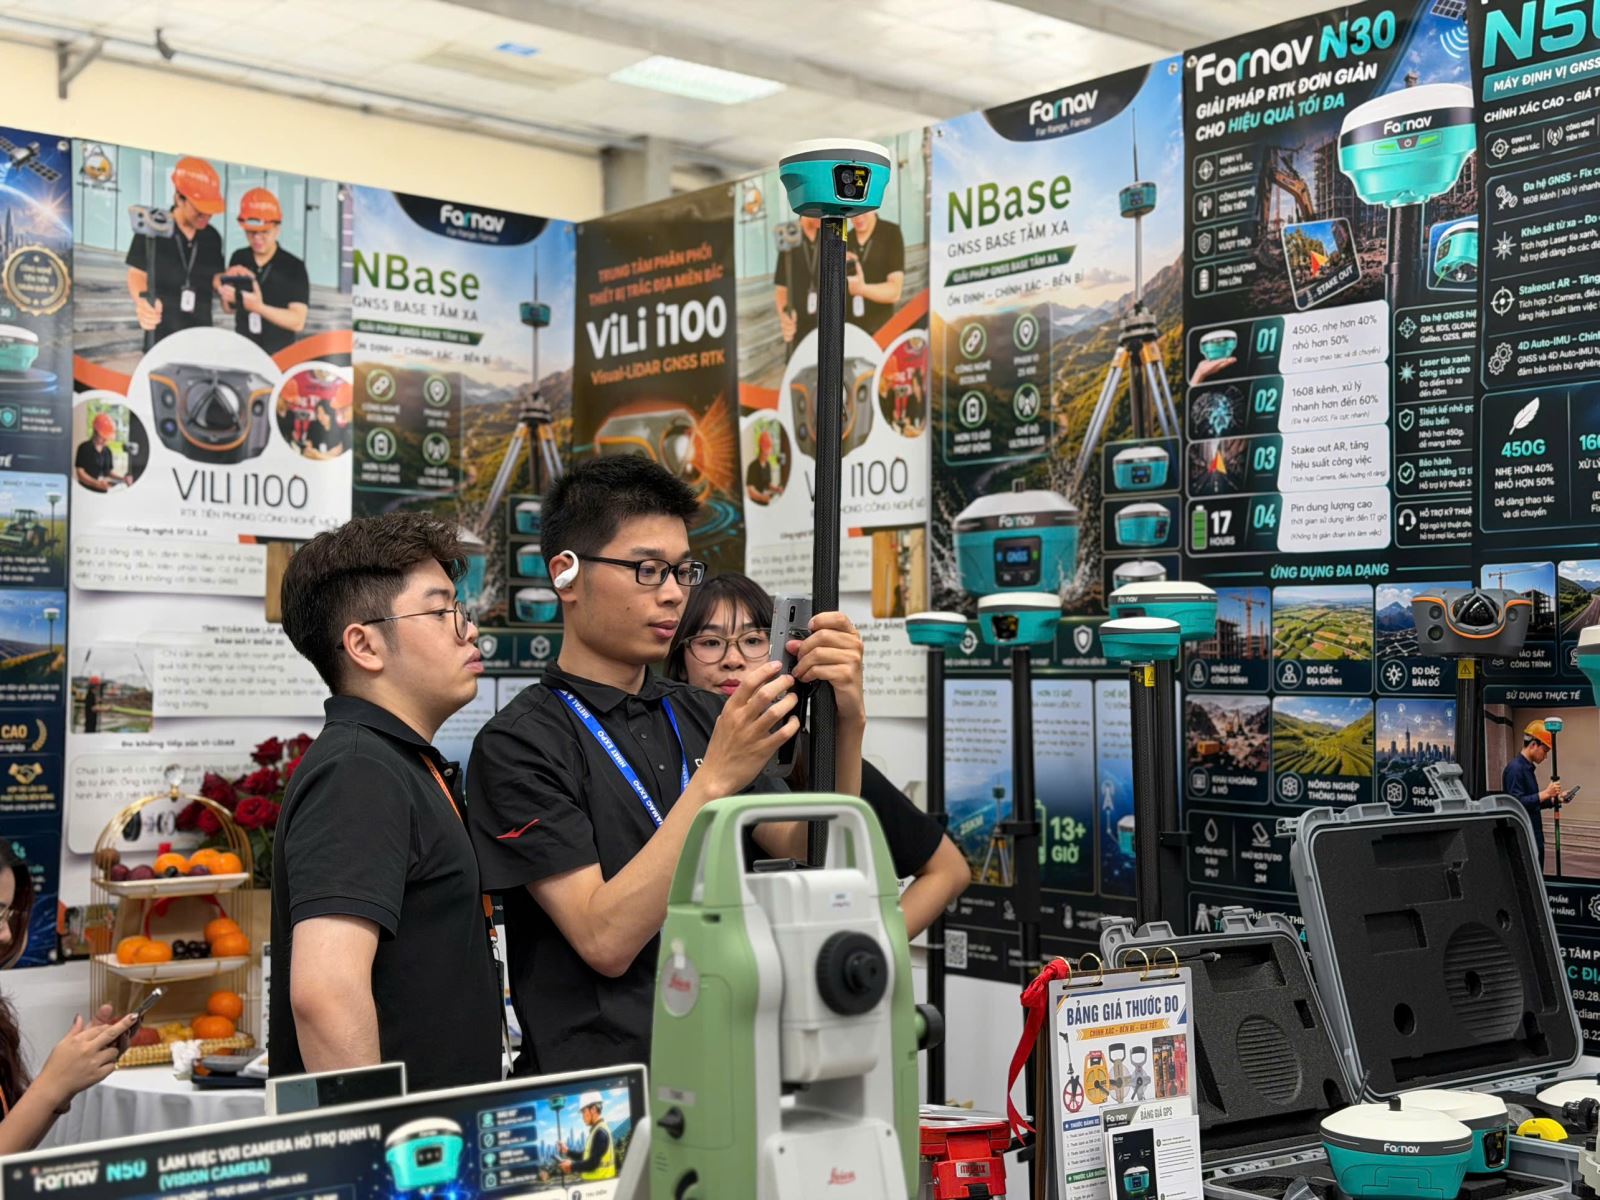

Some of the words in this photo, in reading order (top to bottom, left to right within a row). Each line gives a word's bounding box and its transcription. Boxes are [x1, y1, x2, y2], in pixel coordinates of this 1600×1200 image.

[1482, 0, 1600, 69] N5
[1195, 35, 1314, 92] Farnav
[1318, 9, 1396, 63] N30
[1493, 75, 1519, 92] MÁY
[1522, 71, 1551, 86] ĐỊNH
[1555, 65, 1567, 79] VỊ
[1569, 58, 1600, 74] GNSS
[1196, 96, 1226, 120] GIẢI
[1226, 88, 1265, 114] PHÁP
[1267, 81, 1295, 103] RTK
[1298, 72, 1331, 96] ĐƠN
[1334, 61, 1378, 87] GIẢN
[1029, 89, 1099, 126] Farnav
[1484, 105, 1518, 123] CHÍNH
[1519, 100, 1541, 116] XÁC
[1542, 96, 1564, 110] CAO
[1574, 86, 1592, 102] GIÁ
[1196, 121, 1226, 142] CHO
[1227, 113, 1260, 137] HIỆU
[1263, 107, 1295, 128] QUẢ
[1298, 96, 1320, 118] TỐI
[1322, 92, 1345, 110] ĐA
[1384, 115, 1433, 136] Farnav
[1523, 182, 1535, 193] Đa
[1536, 178, 1546, 190] hệ
[1548, 172, 1572, 186] GNSS
[948, 174, 1072, 234] NBase
[440, 204, 506, 233] Farnav
[948, 238, 982, 258] GNSS
[986, 232, 1016, 251] BASE
[1051, 220, 1070, 236] XA
[352, 250, 480, 301] NBase
[1316, 276, 1340, 298] STAKE
[1339, 264, 1354, 281] OUT
[1519, 280, 1556, 296] Stakeout
[1556, 277, 1570, 288] AR
[352, 295, 390, 312] GNSS
[394, 300, 427, 316] BASE
[462, 309, 479, 322] XA
[1548, 296, 1553, 305] 2
[1554, 292, 1584, 305] Camera,
[586, 306, 648, 360] ViLi
[656, 295, 728, 348] i100
[1322, 320, 1338, 333] nhẹ
[1340, 317, 1356, 329] hơn
[1357, 314, 1378, 326] 40%
[1256, 326, 1278, 353] 01
[1311, 336, 1328, 349] hơn
[1330, 334, 1350, 347] 50%
[1518, 340, 1530, 351] 4D
[1530, 334, 1571, 350] Auto-IMU
[663, 353, 699, 374] GNSS
[700, 348, 726, 368] RTK
[1420, 358, 1440, 368] Laser
[1452, 354, 1471, 364] xanh
[1517, 353, 1538, 365] GNSS
[1548, 350, 1558, 360] 4D
[1559, 346, 1594, 359] Auto-IMU
[1420, 368, 1438, 378] công
[1456, 366, 1470, 374] cao
[1292, 385, 1314, 397] 1608
[1316, 384, 1340, 396] kênh,
[1254, 388, 1278, 414] 02
[1292, 400, 1320, 412] nhanh
[1321, 396, 1338, 409] hơn
[1340, 394, 1358, 408] đến
[1359, 394, 1379, 406] 60%
[1291, 444, 1316, 456] Stake
[1317, 444, 1332, 454] out
[1334, 442, 1349, 452] AR,
[1350, 440, 1370, 453] tăng
[1501, 438, 1547, 458] 450G
[1254, 446, 1276, 472] 03
[1291, 458, 1310, 471] hiệu
[1312, 456, 1330, 468] suất
[1332, 455, 1353, 469] công
[1354, 454, 1372, 466] việc
[1494, 466, 1512, 478] NHẸ
[1514, 464, 1534, 476] HƠN
[1534, 463, 1554, 474] 40%
[172, 468, 230, 504] VILI
[1494, 478, 1514, 490] NHỎ
[1515, 477, 1535, 488] HƠN
[1536, 476, 1555, 487] 50%
[1290, 504, 1304, 512] Pin
[1306, 502, 1328, 514] dung
[1330, 502, 1356, 514] lượng
[1357, 501, 1372, 510] cao
[1506, 496, 1524, 508] dàng
[1525, 495, 1542, 505] thao
[1542, 494, 1555, 504] tác
[1211, 510, 1232, 535] 17
[1254, 504, 1276, 529] 04
[1209, 536, 1236, 547] HOURS
[1006, 550, 1028, 562] GNSS
[1270, 564, 1298, 580] ỨNG
[1300, 565, 1334, 581] DỤNG
[1336, 564, 1356, 578] ĐA
[1356, 563, 1390, 579] DẠNG
[1510, 660, 1530, 668] CÔNG
[1530, 659, 1552, 668] TRÌNH
[1506, 690, 1518, 700] SỬ
[1518, 691, 1543, 702] DỤNG
[1544, 691, 1568, 701] THỰC
[1570, 688, 1582, 700] TẾ
[0, 724, 28, 739] CAO
[598, 730, 613, 750] EXPO
[633, 780, 648, 800] EXPO
[1308, 778, 1330, 790] NÔNG
[1332, 780, 1360, 793] NGHIỆP
[1412, 786, 1426, 796] GIS
[1428, 786, 1435, 796] &
[1308, 790, 1335, 802] THÔNG
[1336, 791, 1358, 802] MINH
[1050, 816, 1086, 842] 13+
[1052, 844, 1080, 864] GIỜ
[1569, 946, 1591, 960] TÂM
[1582, 967, 1600, 984] ĐỊ
[1066, 998, 1099, 1026] BẢNG
[1102, 998, 1123, 1020] GIÁ
[1126, 994, 1162, 1018] THƯỚC
[1164, 994, 1180, 1014] ĐO
[1140, 1108, 1154, 1121] BẢNG
[1154, 1108, 1162, 1120] GIÁ
[1163, 1106, 1173, 1118] GPS
[158, 1154, 188, 1172] LÀM
[188, 1149, 218, 1168] VIỆC
[242, 1139, 293, 1159] CAMERA
[314, 1131, 338, 1149] TRỢ
[338, 1128, 367, 1148] ĐỊNH
[368, 1124, 382, 1142] VỊ
[1384, 1143, 1420, 1153] Farnav
[34, 1165, 99, 1192] Farnav
[106, 1160, 148, 1183] N50
[158, 1170, 209, 1192] (VISION
[211, 1158, 272, 1184] CAMERA)
